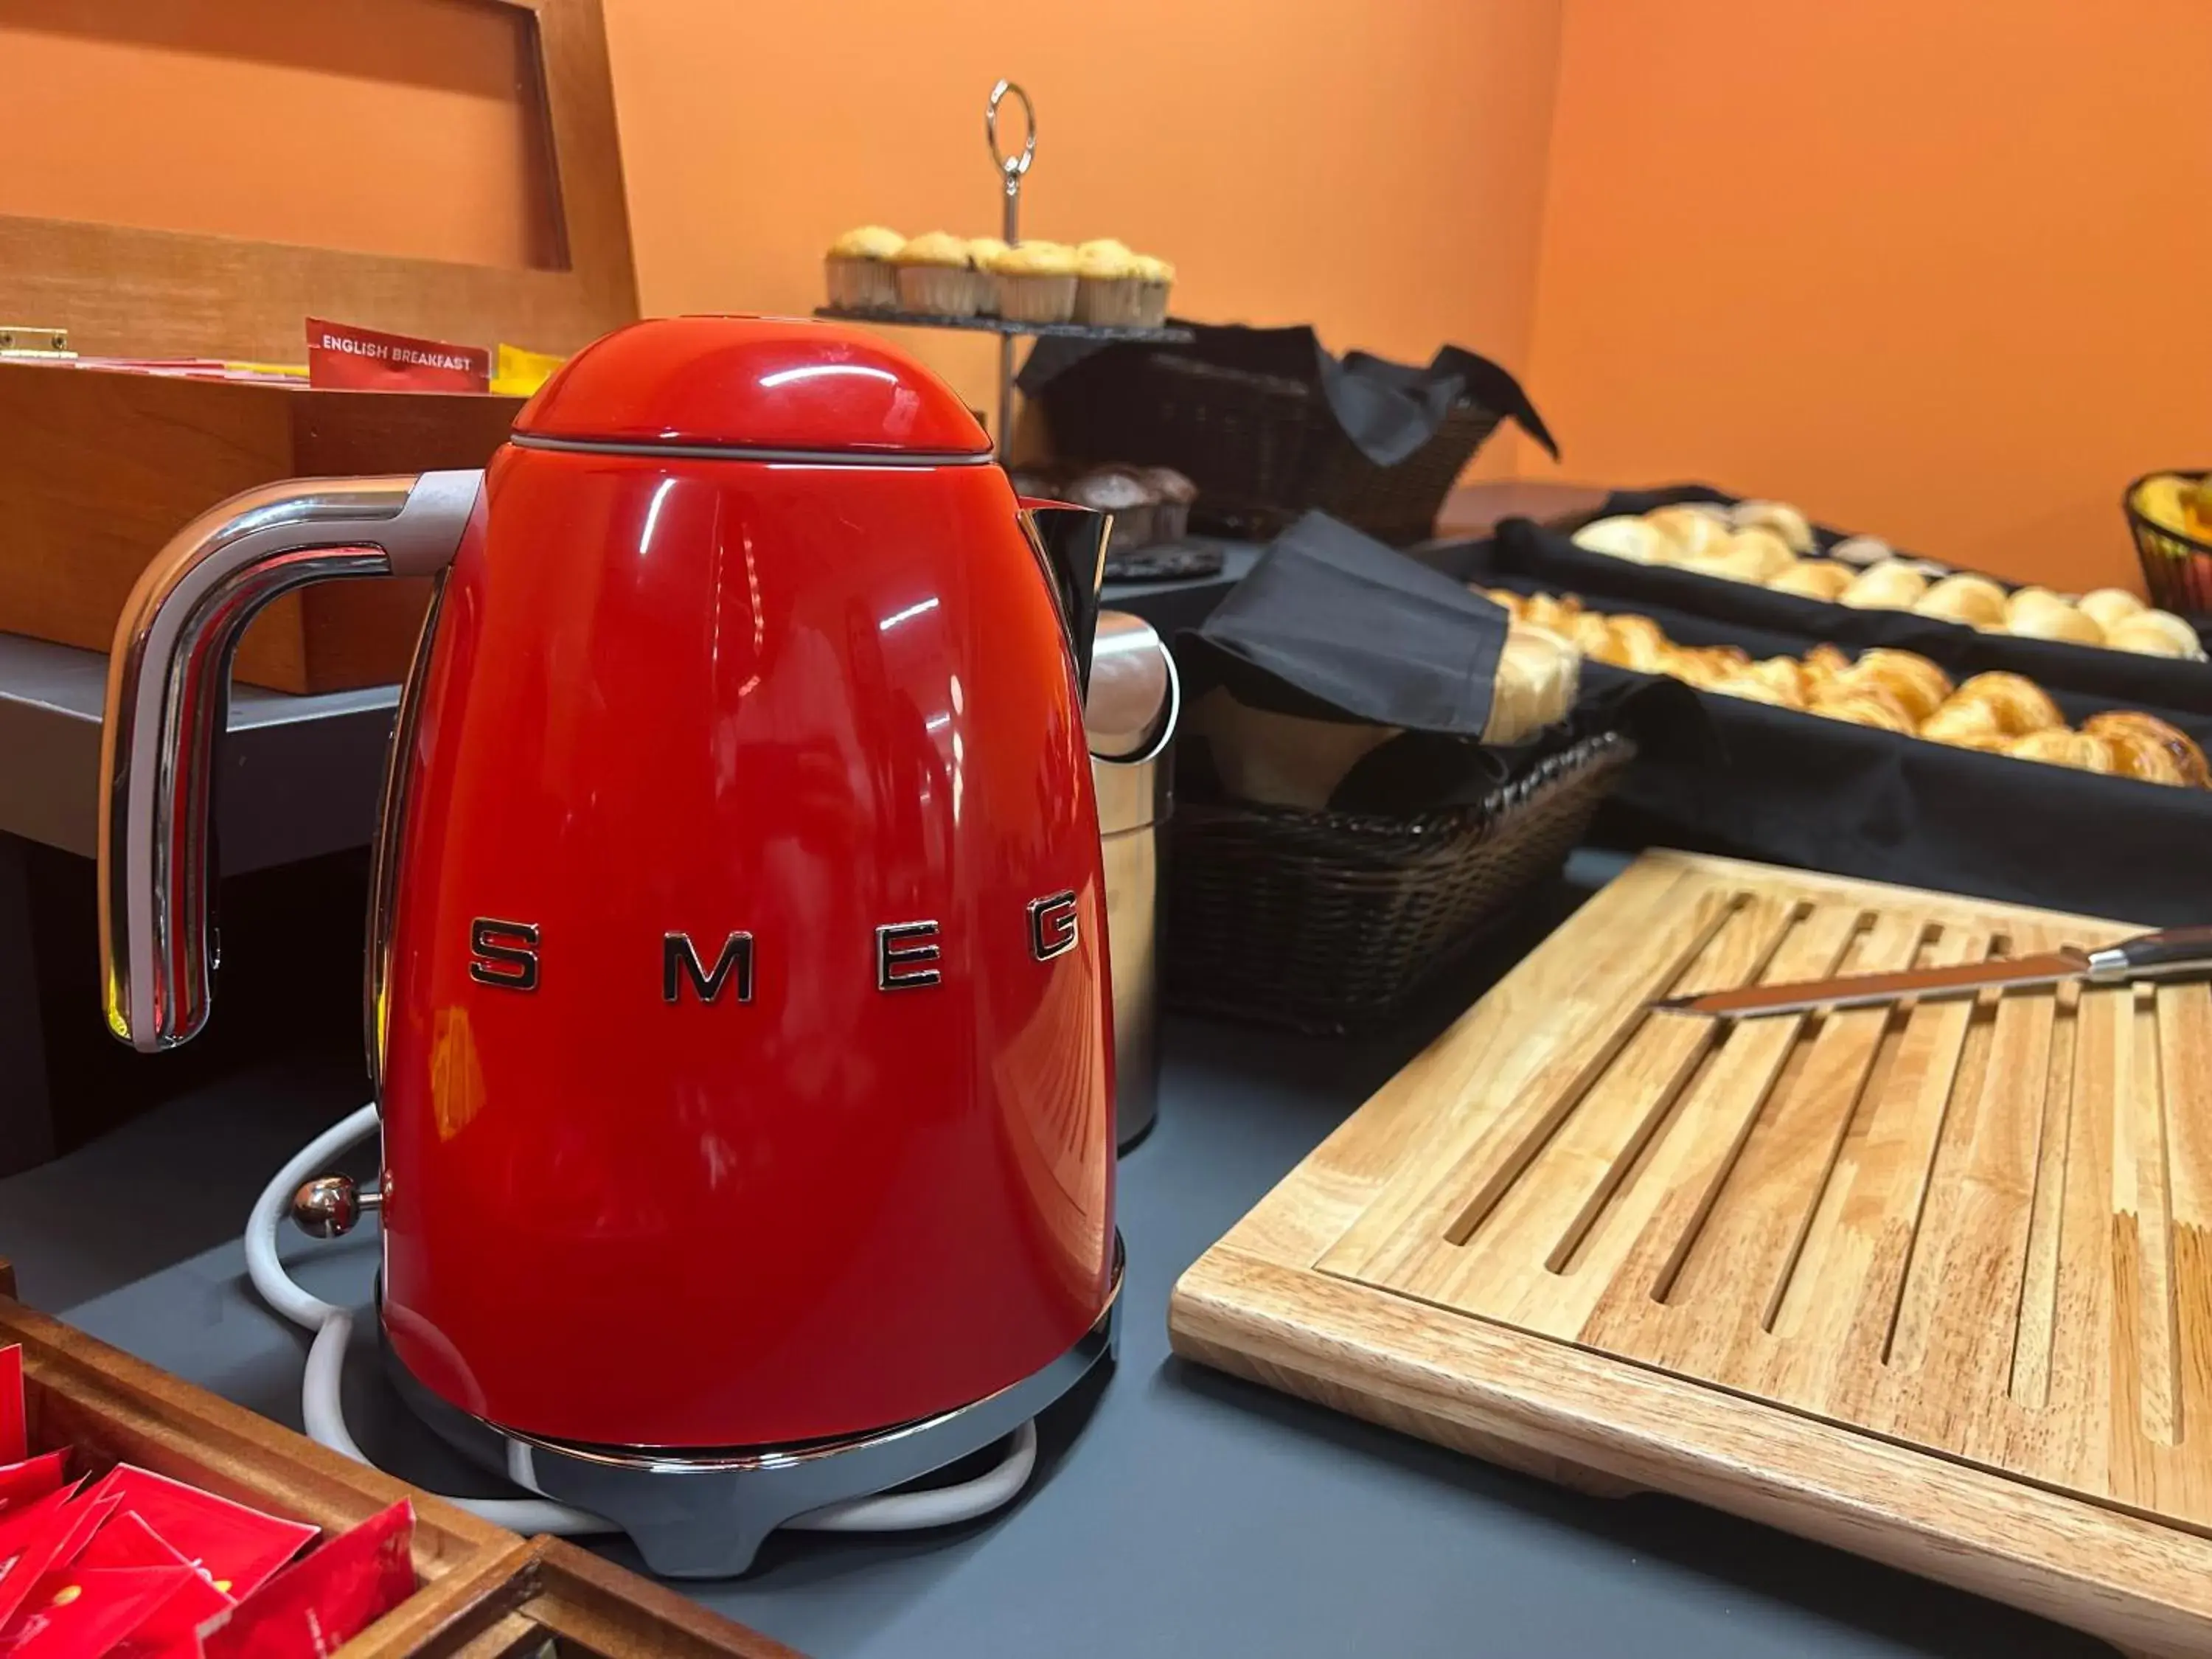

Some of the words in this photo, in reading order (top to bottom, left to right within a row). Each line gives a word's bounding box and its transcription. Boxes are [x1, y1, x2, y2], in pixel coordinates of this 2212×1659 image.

[322, 334, 388, 359] ENGLISH
[392, 347, 471, 371] BREAKFAST
[468, 888, 1079, 1004] SMEG
